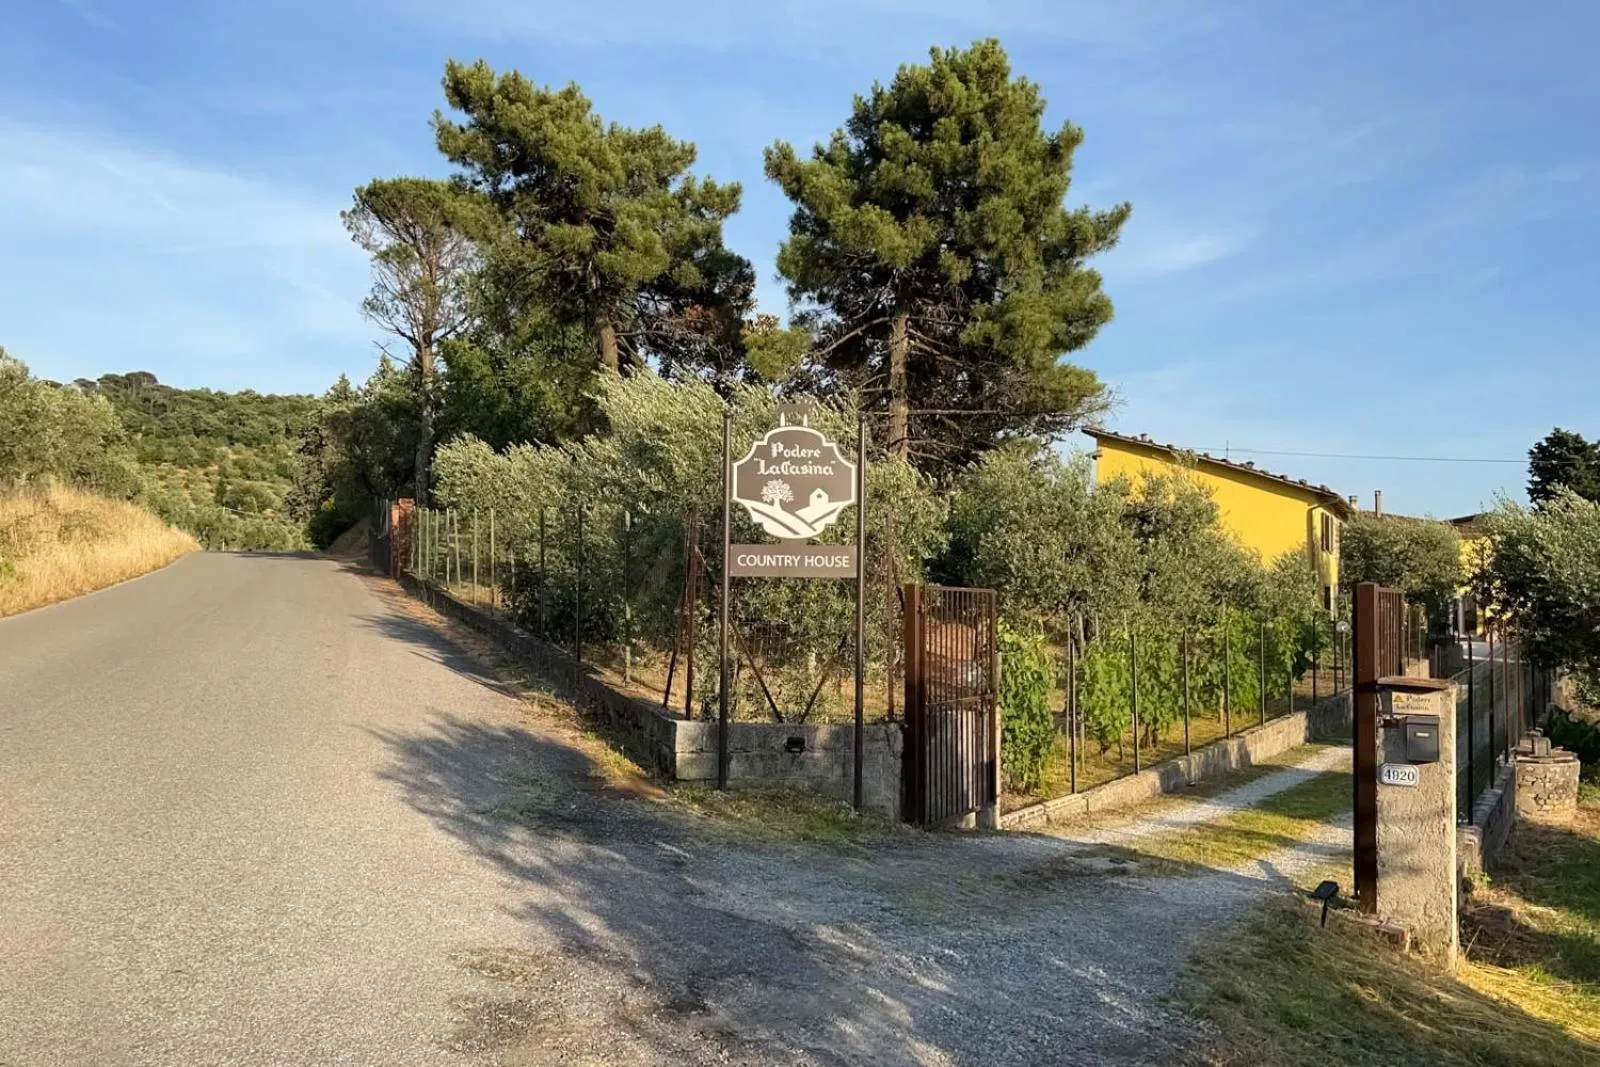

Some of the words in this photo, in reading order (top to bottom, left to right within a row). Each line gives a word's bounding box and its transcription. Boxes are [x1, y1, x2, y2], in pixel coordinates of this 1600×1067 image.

[771, 441, 821, 458] Podere
[737, 554, 801, 567] COUNTRY
[804, 555, 850, 568] HOUSE
[1385, 769, 1415, 781] 4920
